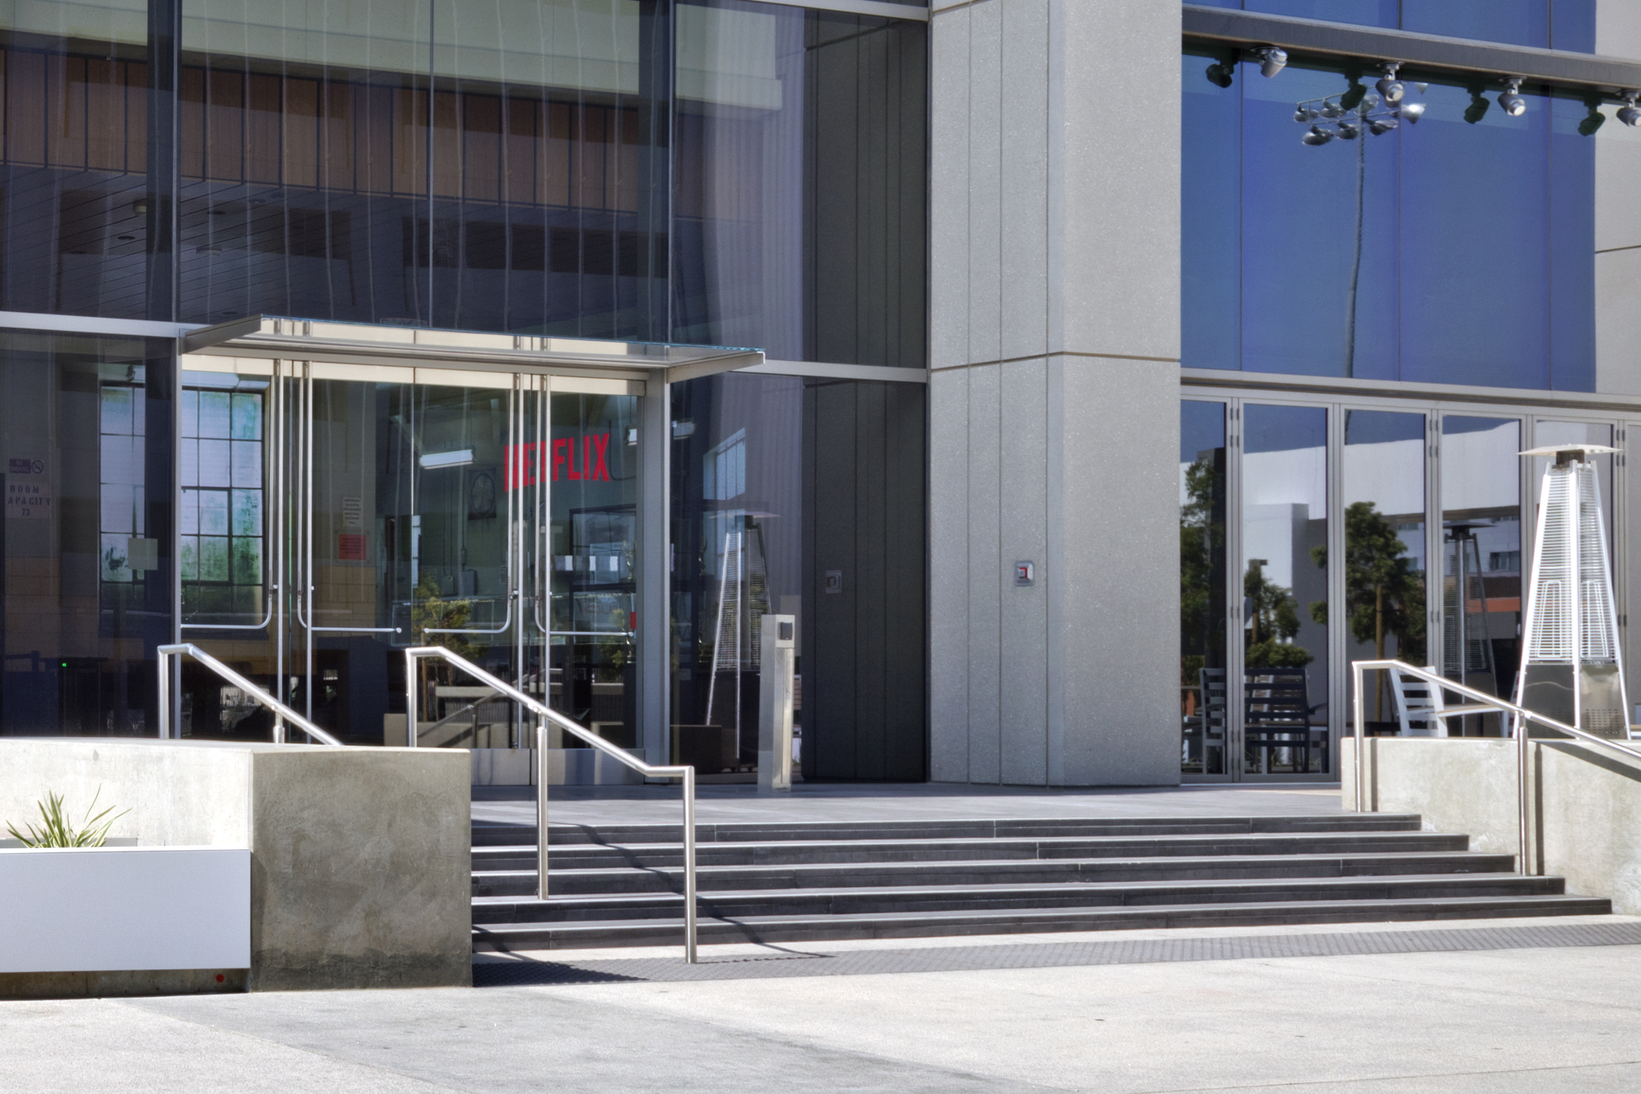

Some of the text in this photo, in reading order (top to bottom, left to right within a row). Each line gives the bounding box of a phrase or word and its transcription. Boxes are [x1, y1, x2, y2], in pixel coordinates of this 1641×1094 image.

[10, 485, 39, 494] ROOM
[8, 496, 51, 505] APACITY
[21, 508, 30, 516] 73
